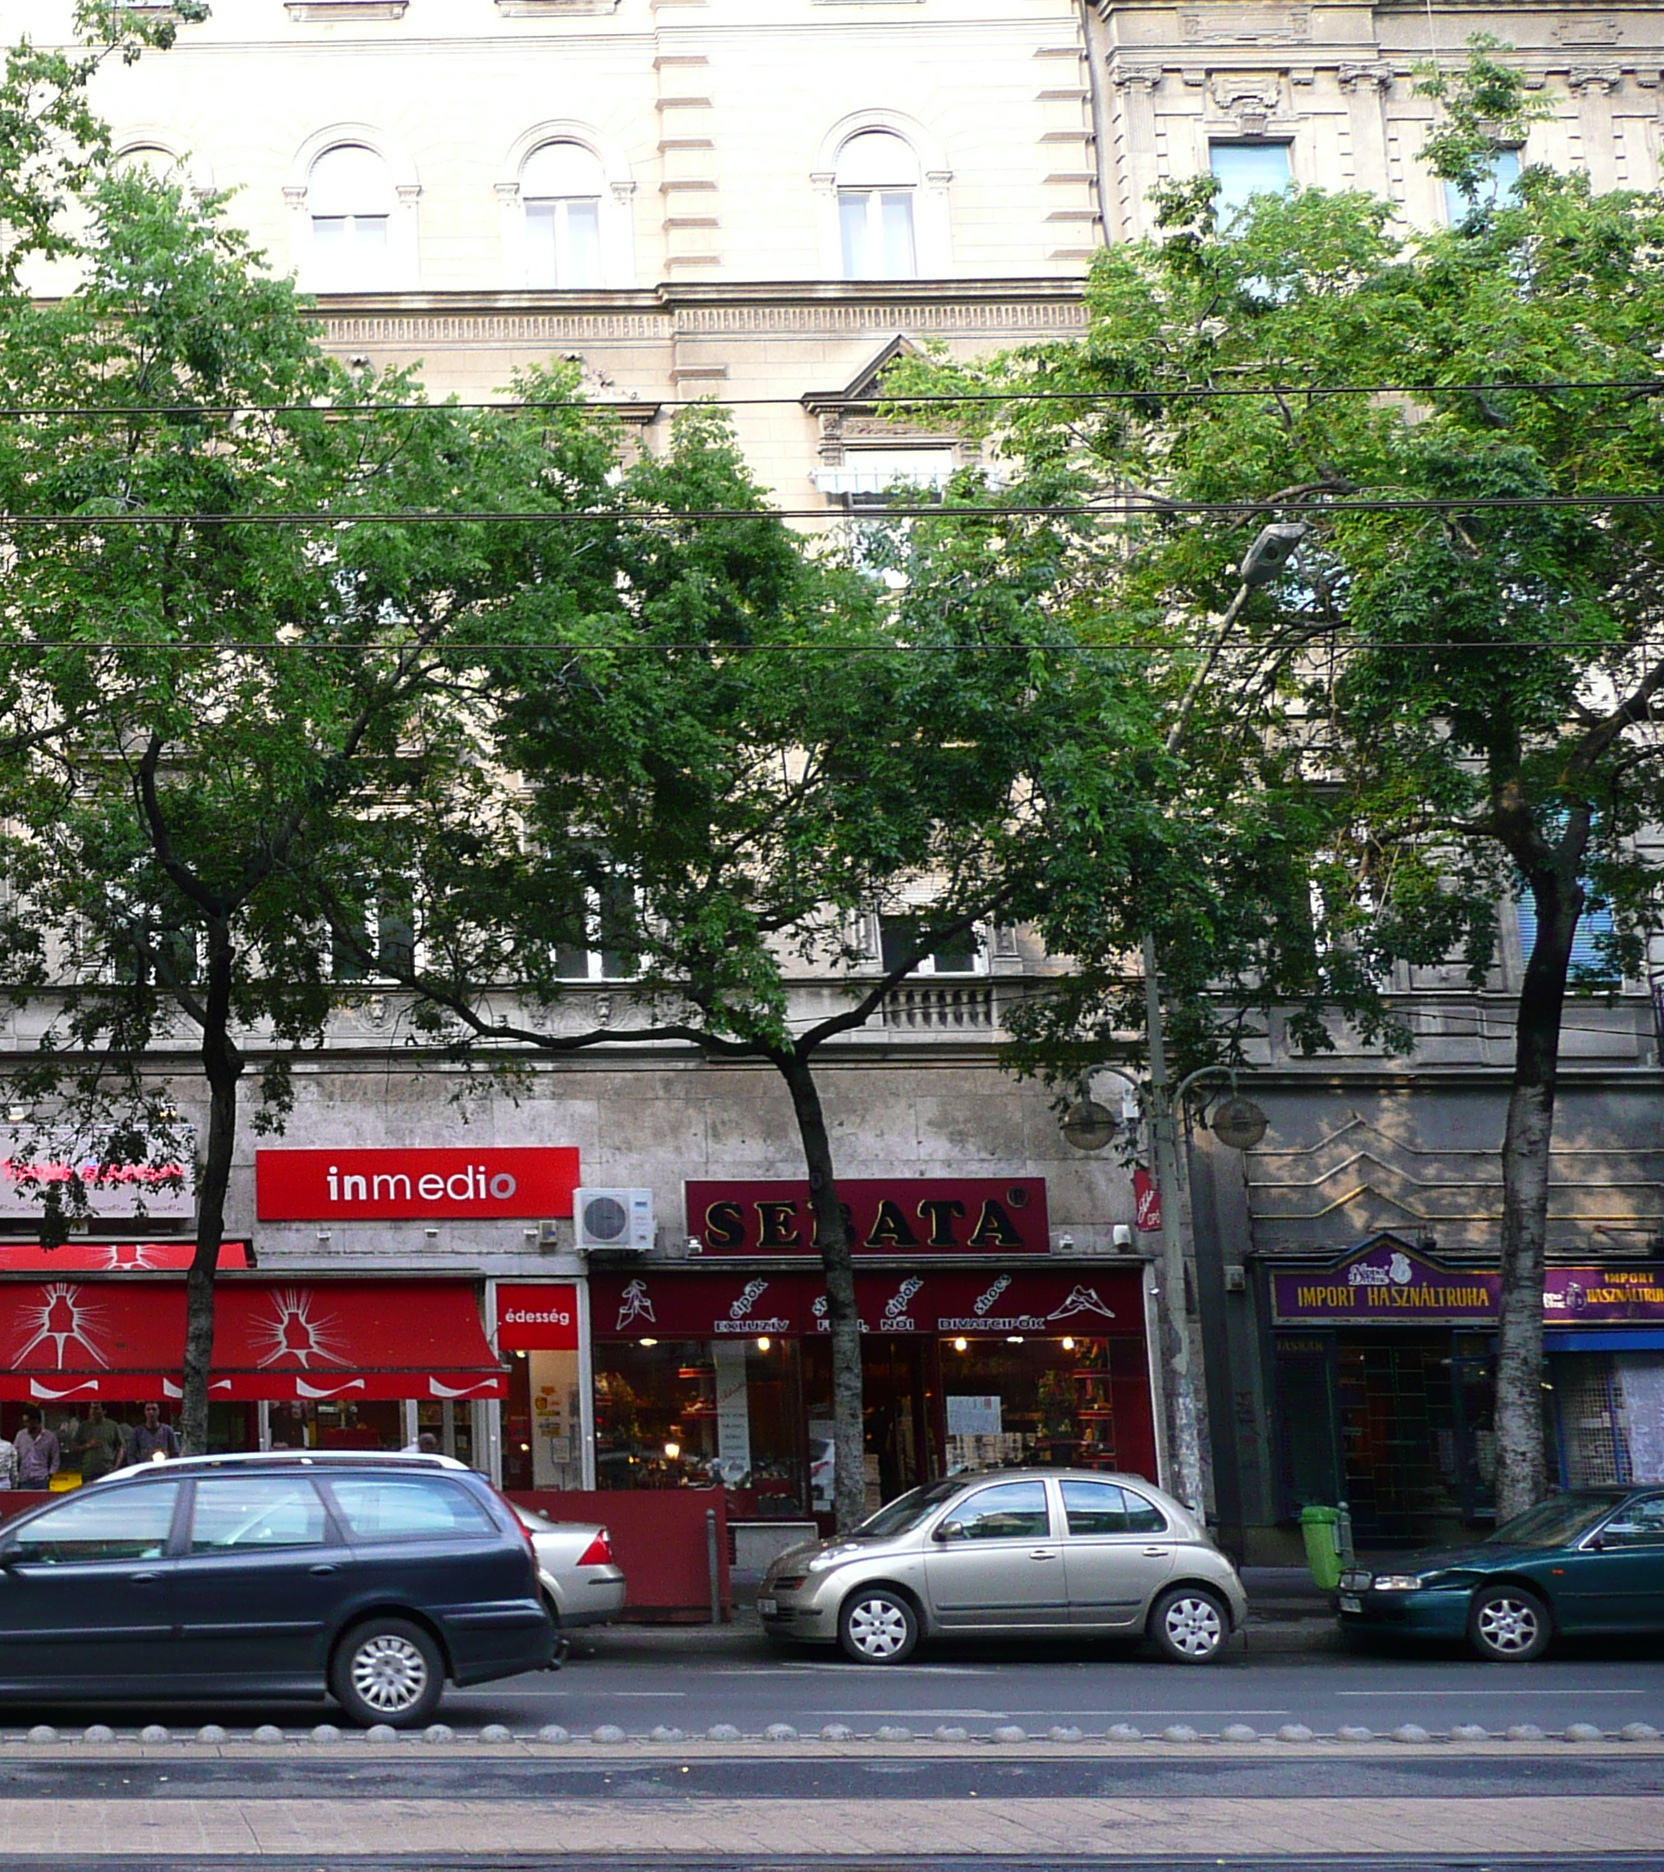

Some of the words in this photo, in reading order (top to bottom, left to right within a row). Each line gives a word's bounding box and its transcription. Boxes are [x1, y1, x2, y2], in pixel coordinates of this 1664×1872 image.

[326, 1165, 517, 1200] inmedio
[1604, 1273, 1655, 1283] IMPORT
[885, 1275, 924, 1317] cipők
[973, 1273, 1013, 1316] shoes
[1297, 1286, 1356, 1307] IMPORT
[1367, 1282, 1490, 1307] HASZNÁLTRUHA
[505, 1308, 570, 1326] édesség
[714, 1317, 790, 1332] EXLUZÍV
[880, 1316, 914, 1330] NŐI
[938, 1315, 1046, 1330] DIVATCIPŐK
